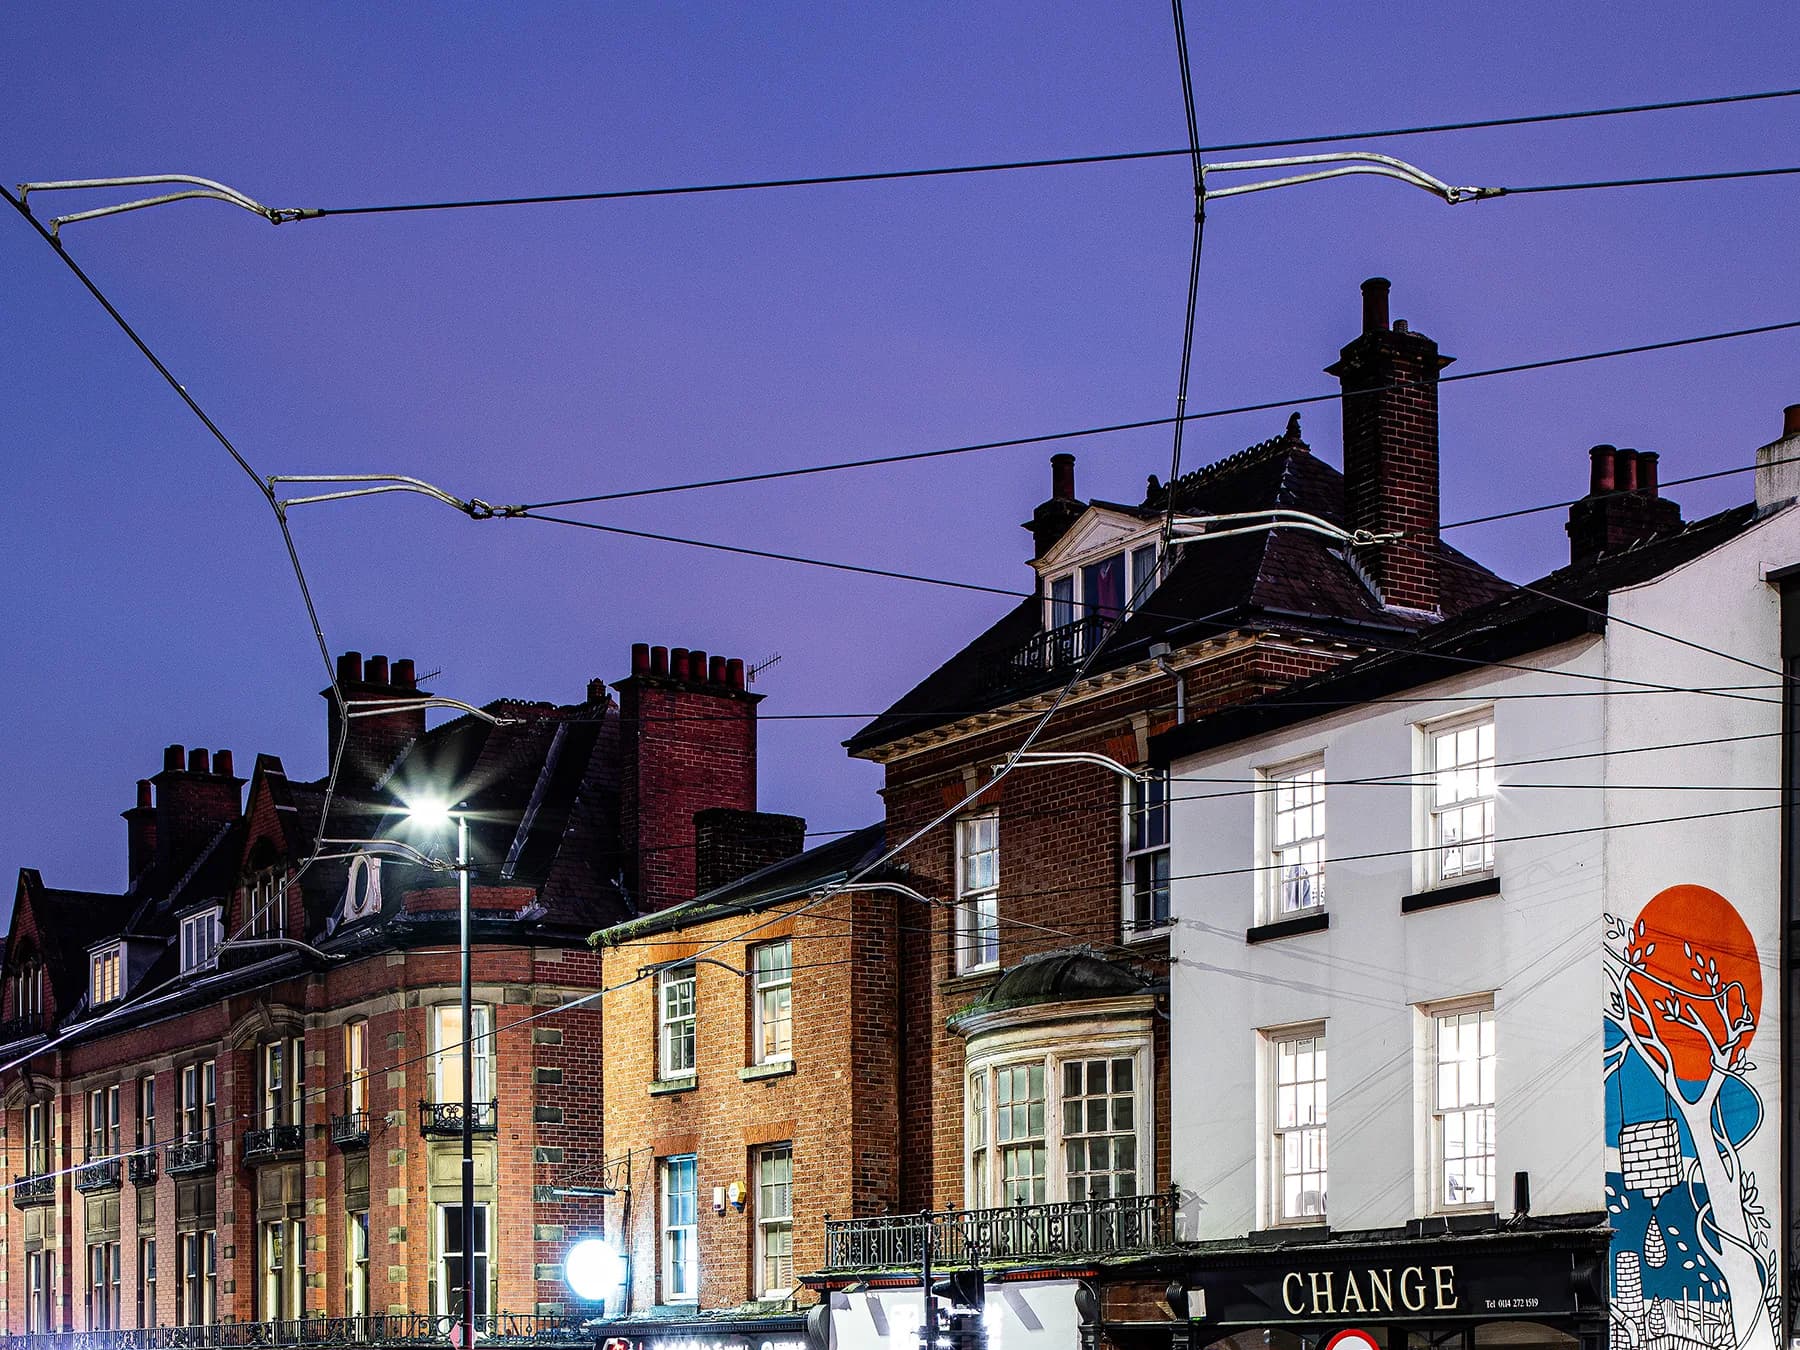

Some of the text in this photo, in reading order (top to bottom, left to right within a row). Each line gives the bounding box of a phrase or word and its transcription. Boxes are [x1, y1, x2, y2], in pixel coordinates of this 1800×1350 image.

[1282, 1265, 1459, 1315] CHANGE
[1484, 1297, 1539, 1309] Tel 0114 272 1519
